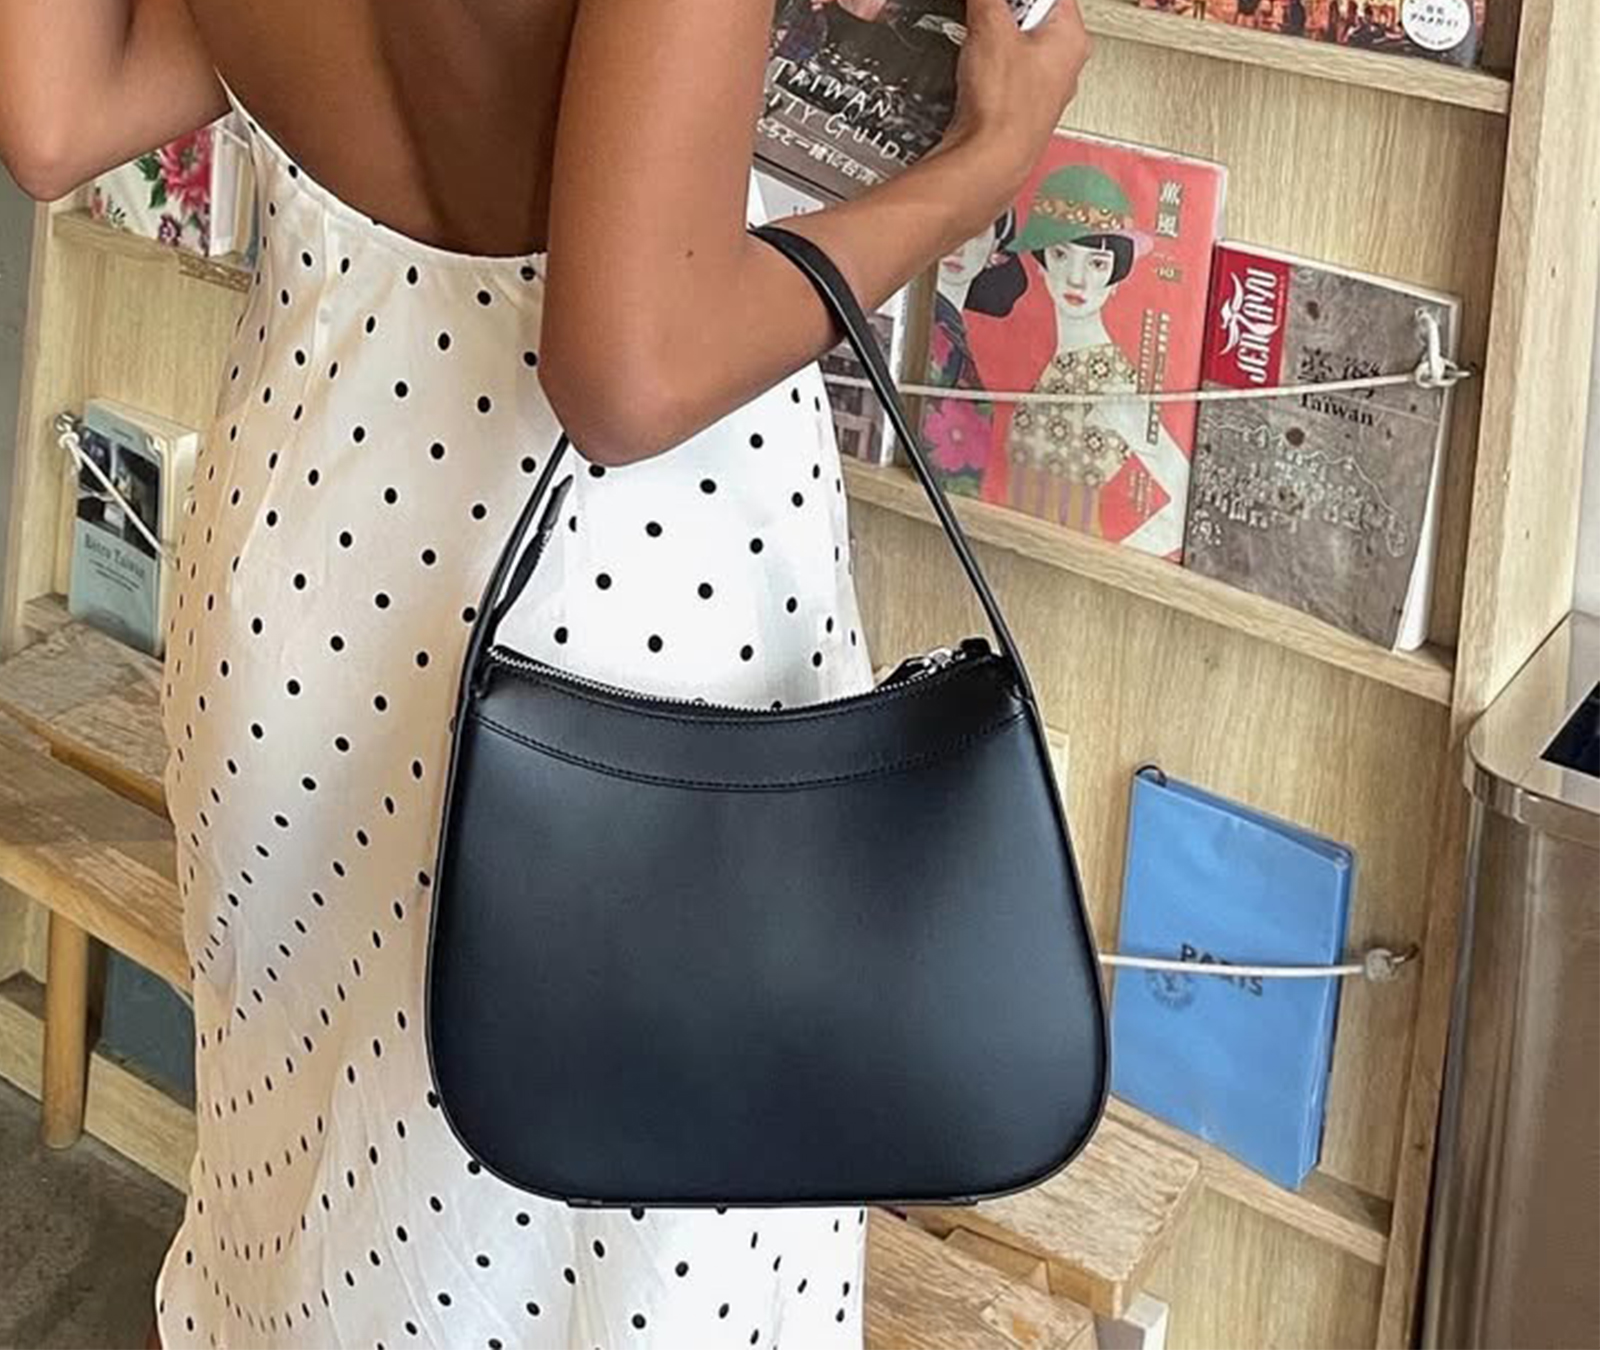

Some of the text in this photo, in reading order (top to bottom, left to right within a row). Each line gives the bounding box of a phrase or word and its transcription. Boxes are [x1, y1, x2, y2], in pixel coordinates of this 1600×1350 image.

[772, 55, 891, 118] TAIWAN
[769, 92, 919, 167] ITY GUIDE
[1300, 392, 1373, 426] Taiwan
